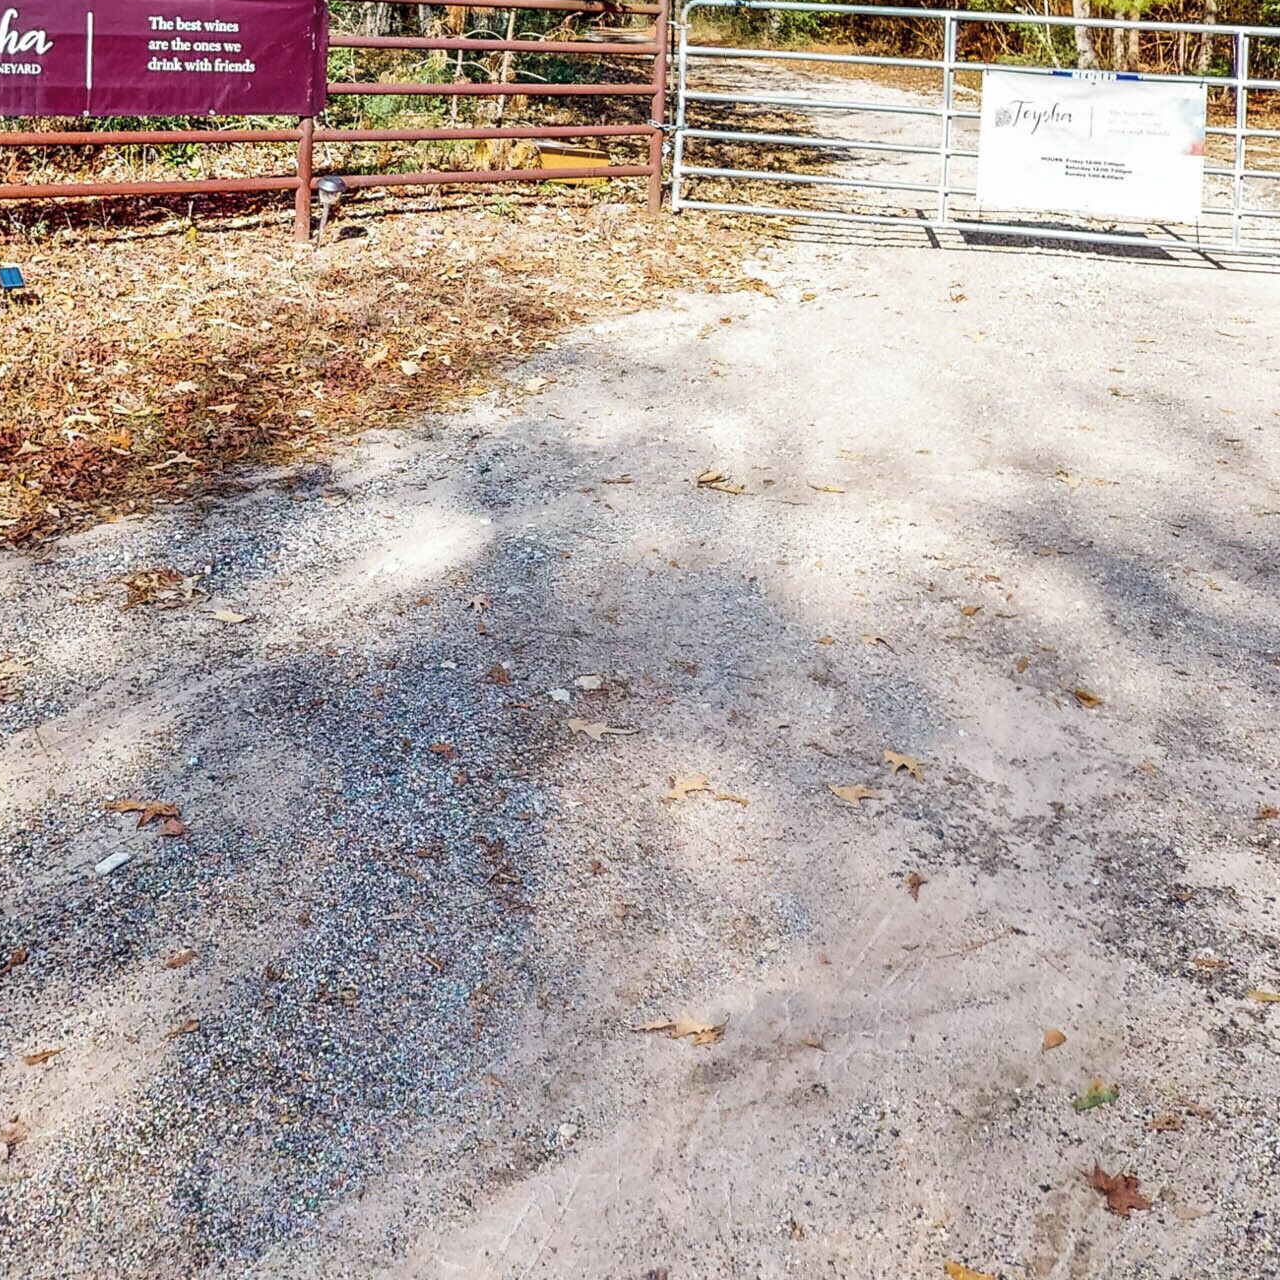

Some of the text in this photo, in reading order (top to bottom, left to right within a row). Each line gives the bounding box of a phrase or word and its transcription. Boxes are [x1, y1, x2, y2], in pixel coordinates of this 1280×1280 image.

[148, 16, 239, 32] The best wines
[148, 37, 242, 52] are the ones we
[147, 57, 255, 72] drink with friends
[1010, 100, 1072, 135] Teysha
